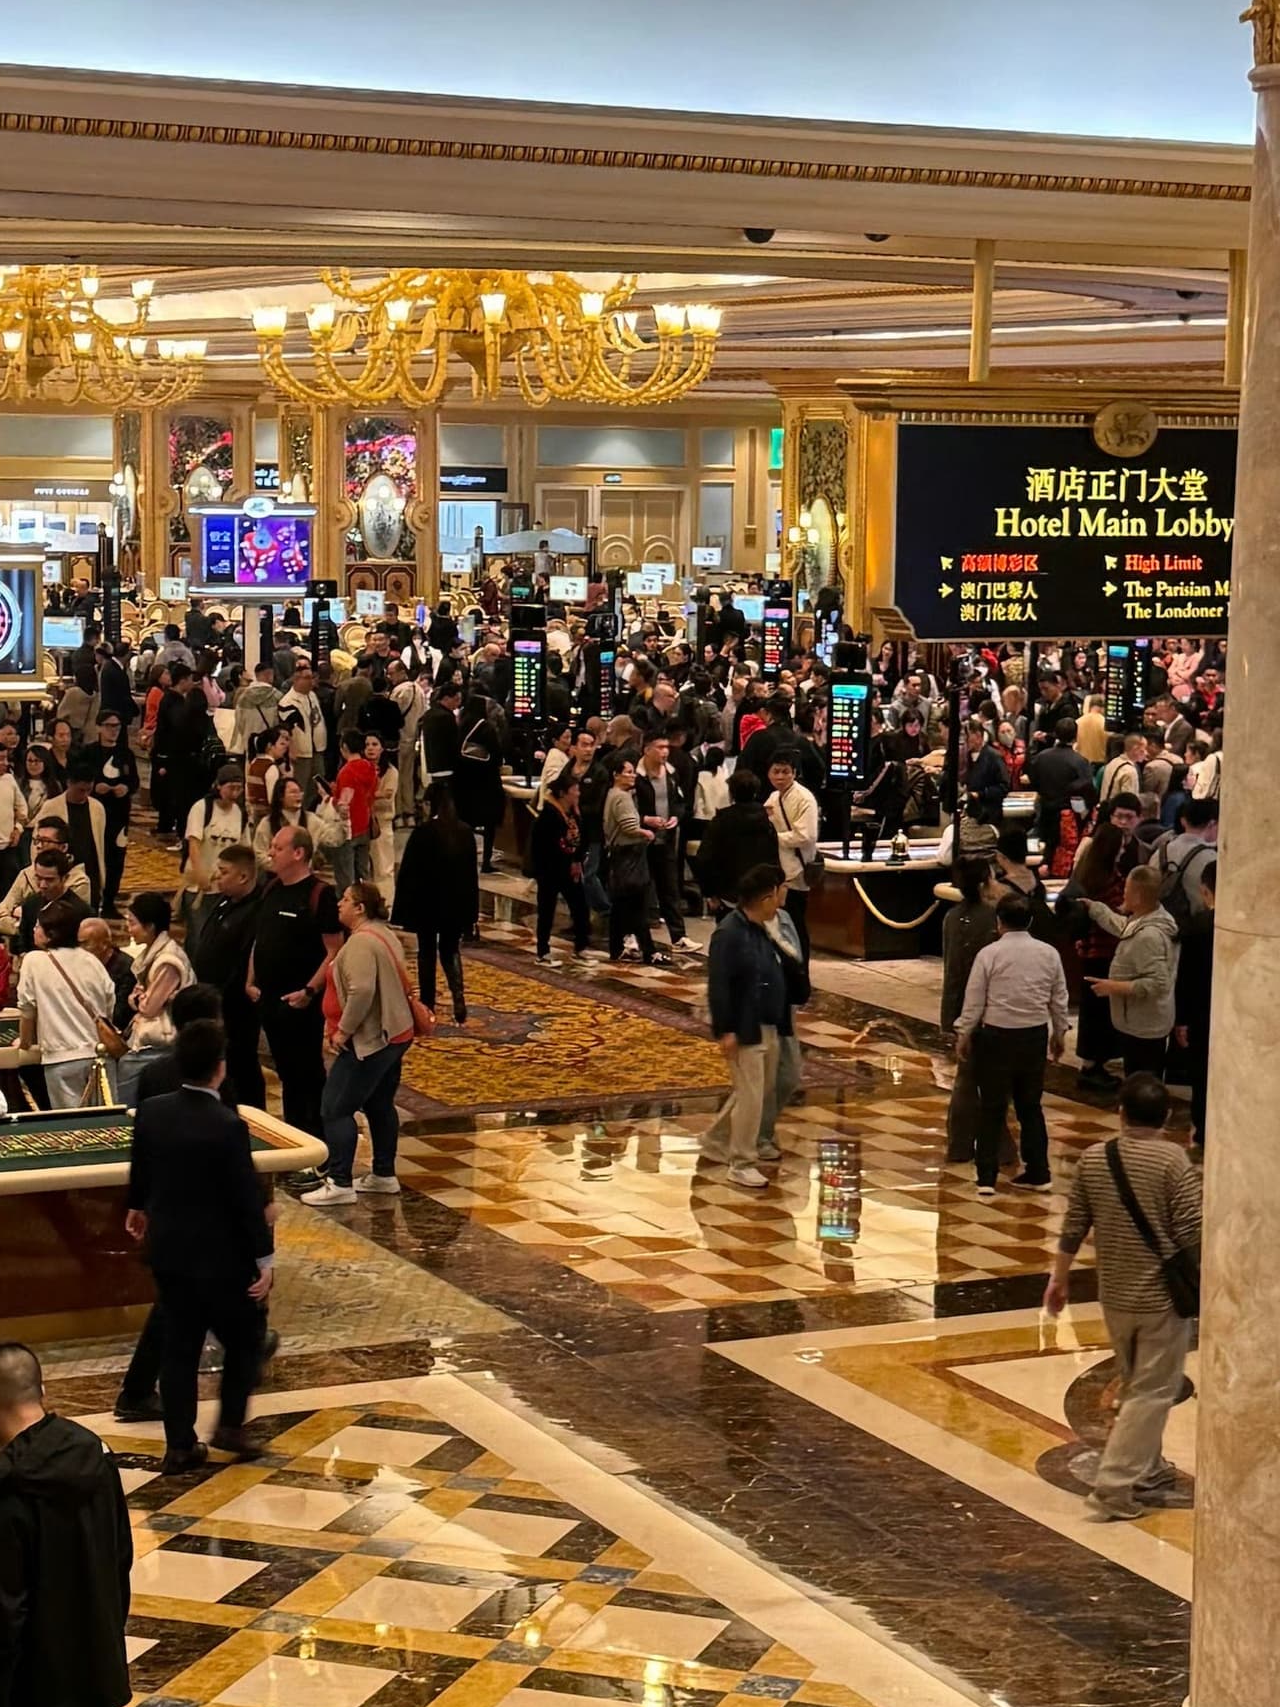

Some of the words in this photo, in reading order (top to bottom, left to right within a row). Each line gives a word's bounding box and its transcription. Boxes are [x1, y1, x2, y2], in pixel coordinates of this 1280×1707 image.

[1025, 466, 1208, 503] 酒店正门大堂
[994, 507, 1071, 537] Hotel
[1078, 507, 1148, 537] Main
[1155, 507, 1235, 543] Lobby
[1125, 554, 1160, 574] High
[1164, 554, 1203, 571] Limit
[960, 581, 1038, 600] 澳门巴黎人
[1123, 580, 1153, 598] The
[1156, 581, 1211, 598] Parisian
[960, 603, 1038, 622] 澳门伦敦人
[1122, 602, 1152, 620] The
[1154, 601, 1223, 619] Londoner
